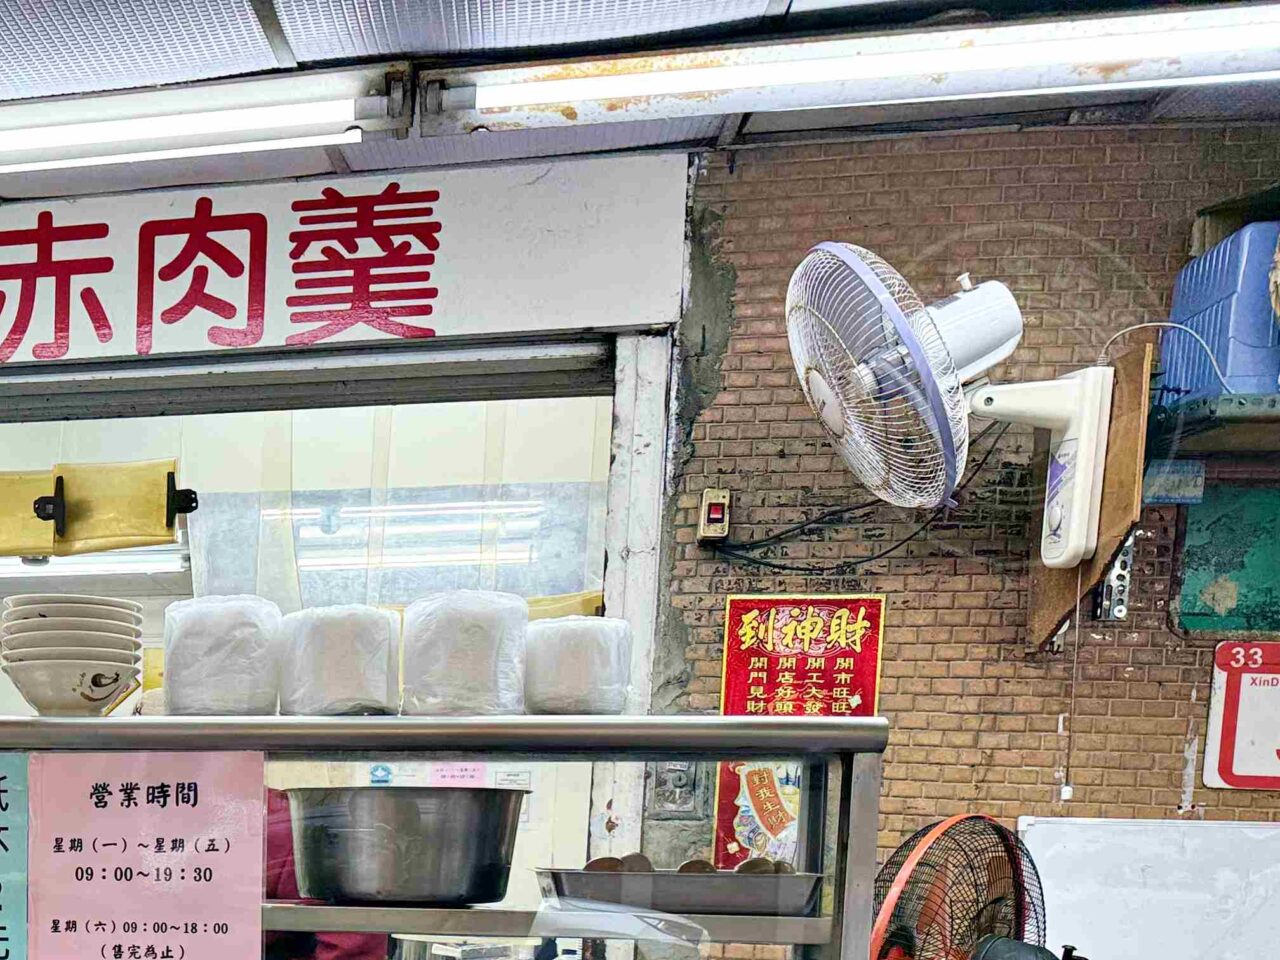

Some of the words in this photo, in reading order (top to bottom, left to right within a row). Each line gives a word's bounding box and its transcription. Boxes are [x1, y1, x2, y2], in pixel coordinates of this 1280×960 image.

[745, 657, 768, 713] 開門見財
[804, 657, 825, 713] 開工大發
[832, 657, 854, 713] 開市旺旺
[1230, 647, 1263, 668] 33
[89, 781, 199, 809] 營業時間
